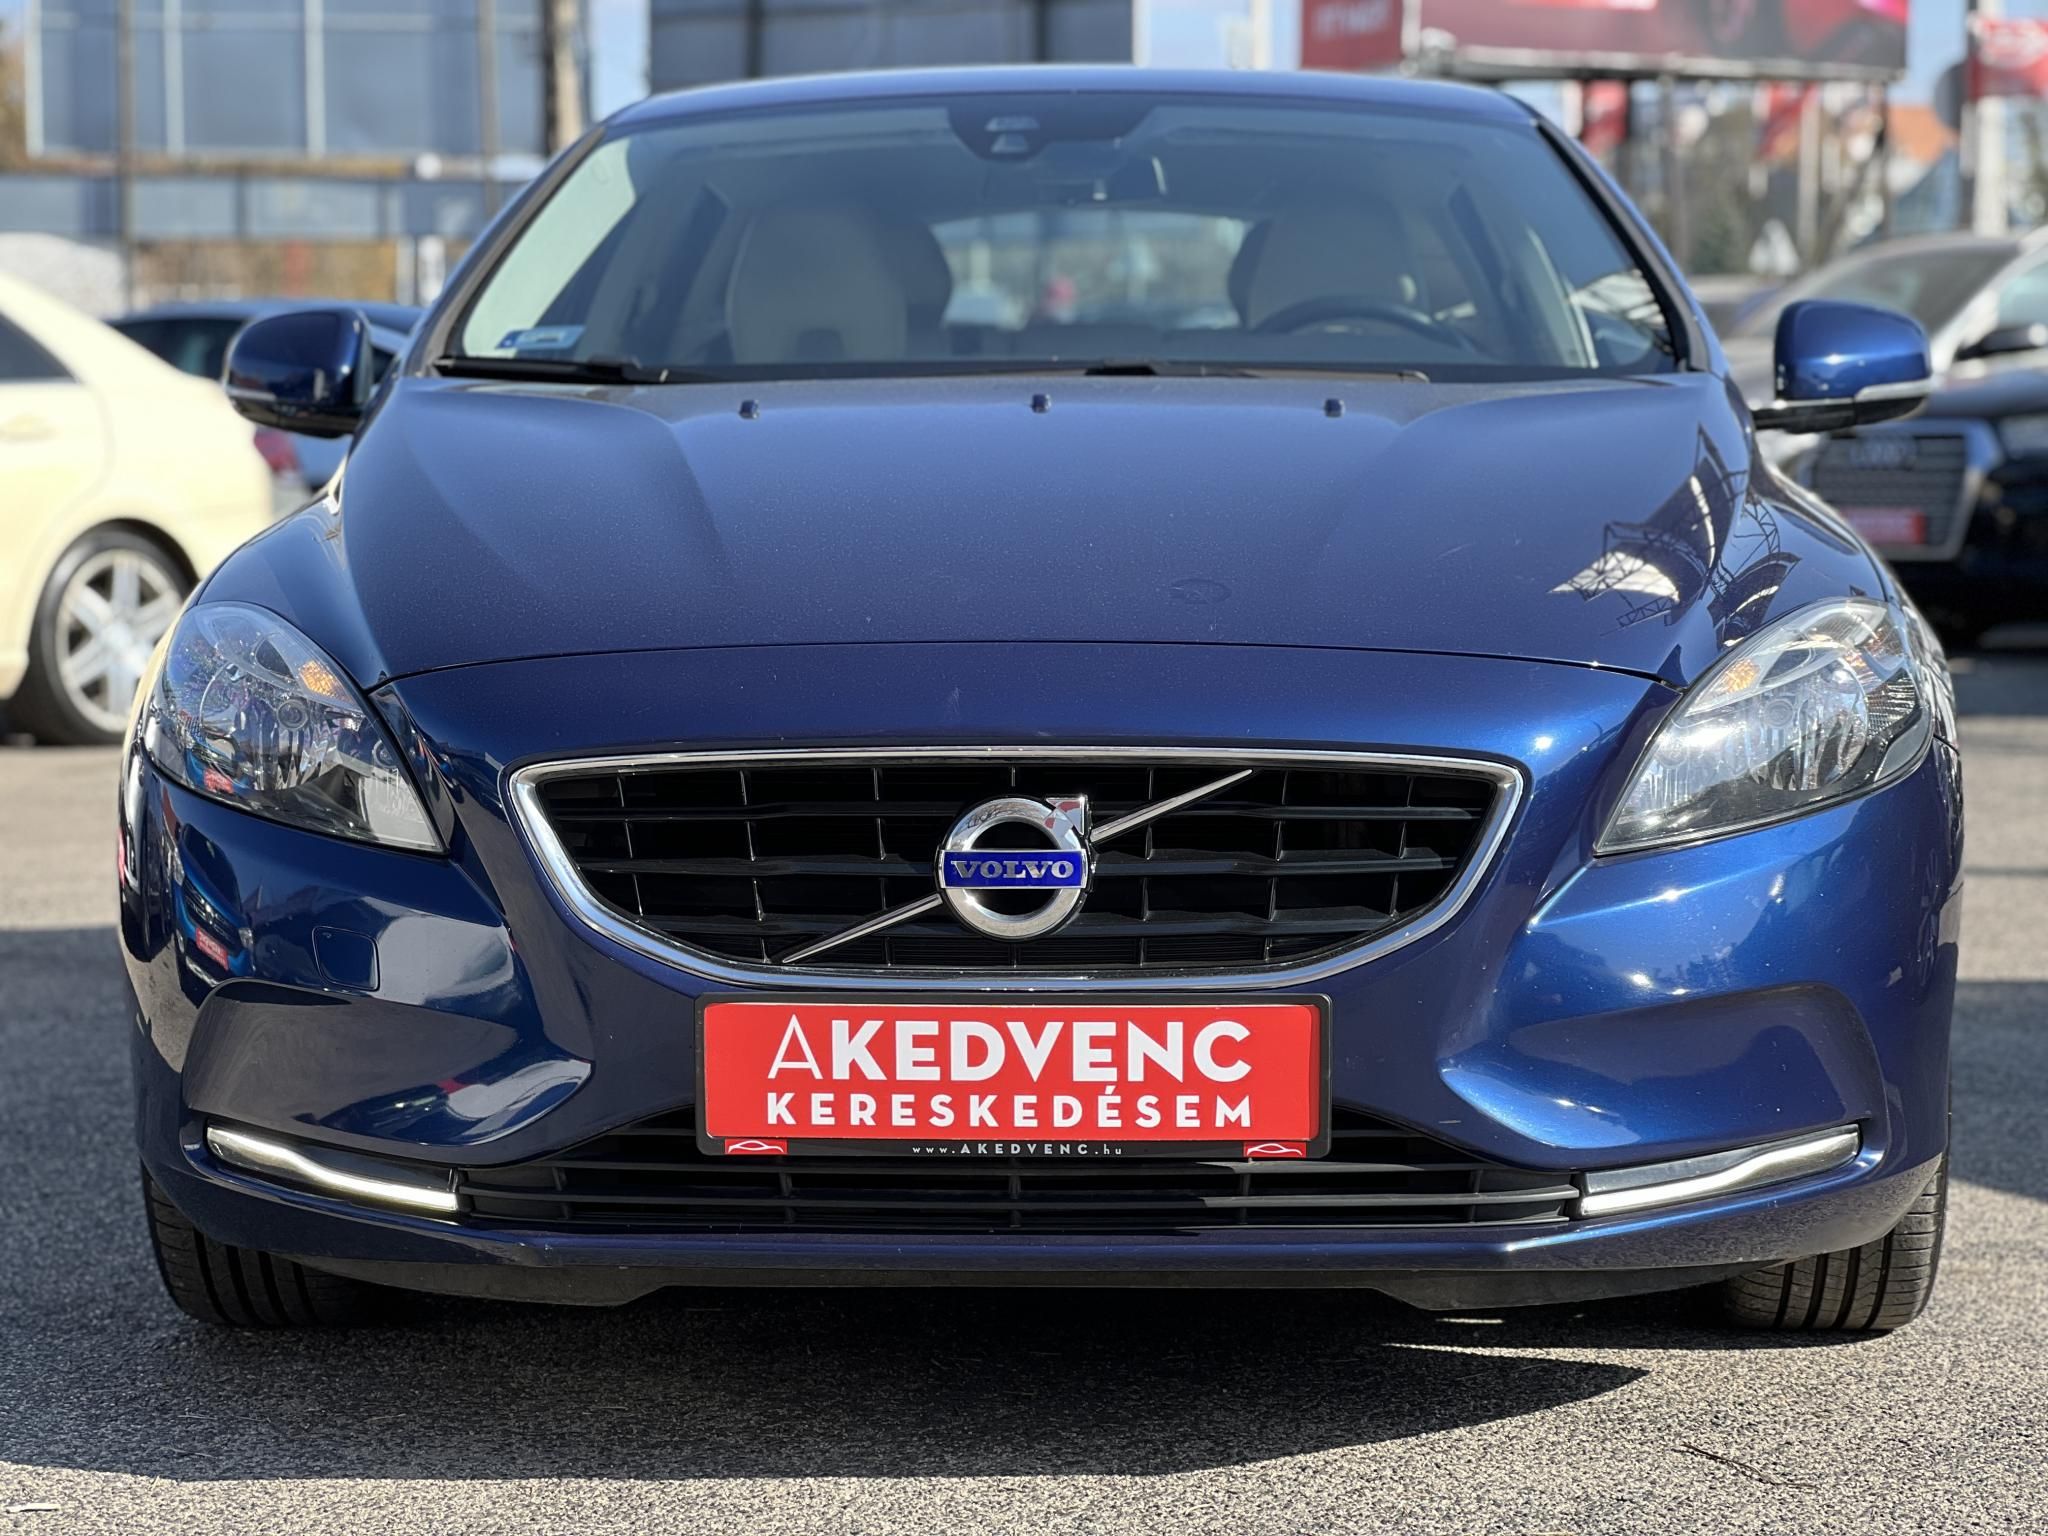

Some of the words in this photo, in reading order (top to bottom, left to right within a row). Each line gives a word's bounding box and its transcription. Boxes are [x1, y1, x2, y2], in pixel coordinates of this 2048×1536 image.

[950, 860, 1074, 879] VOLVO
[766, 1084, 1252, 1129] KERESKEDÉSEM
[912, 1142, 1122, 1156] www.AKEDVENC.hu
